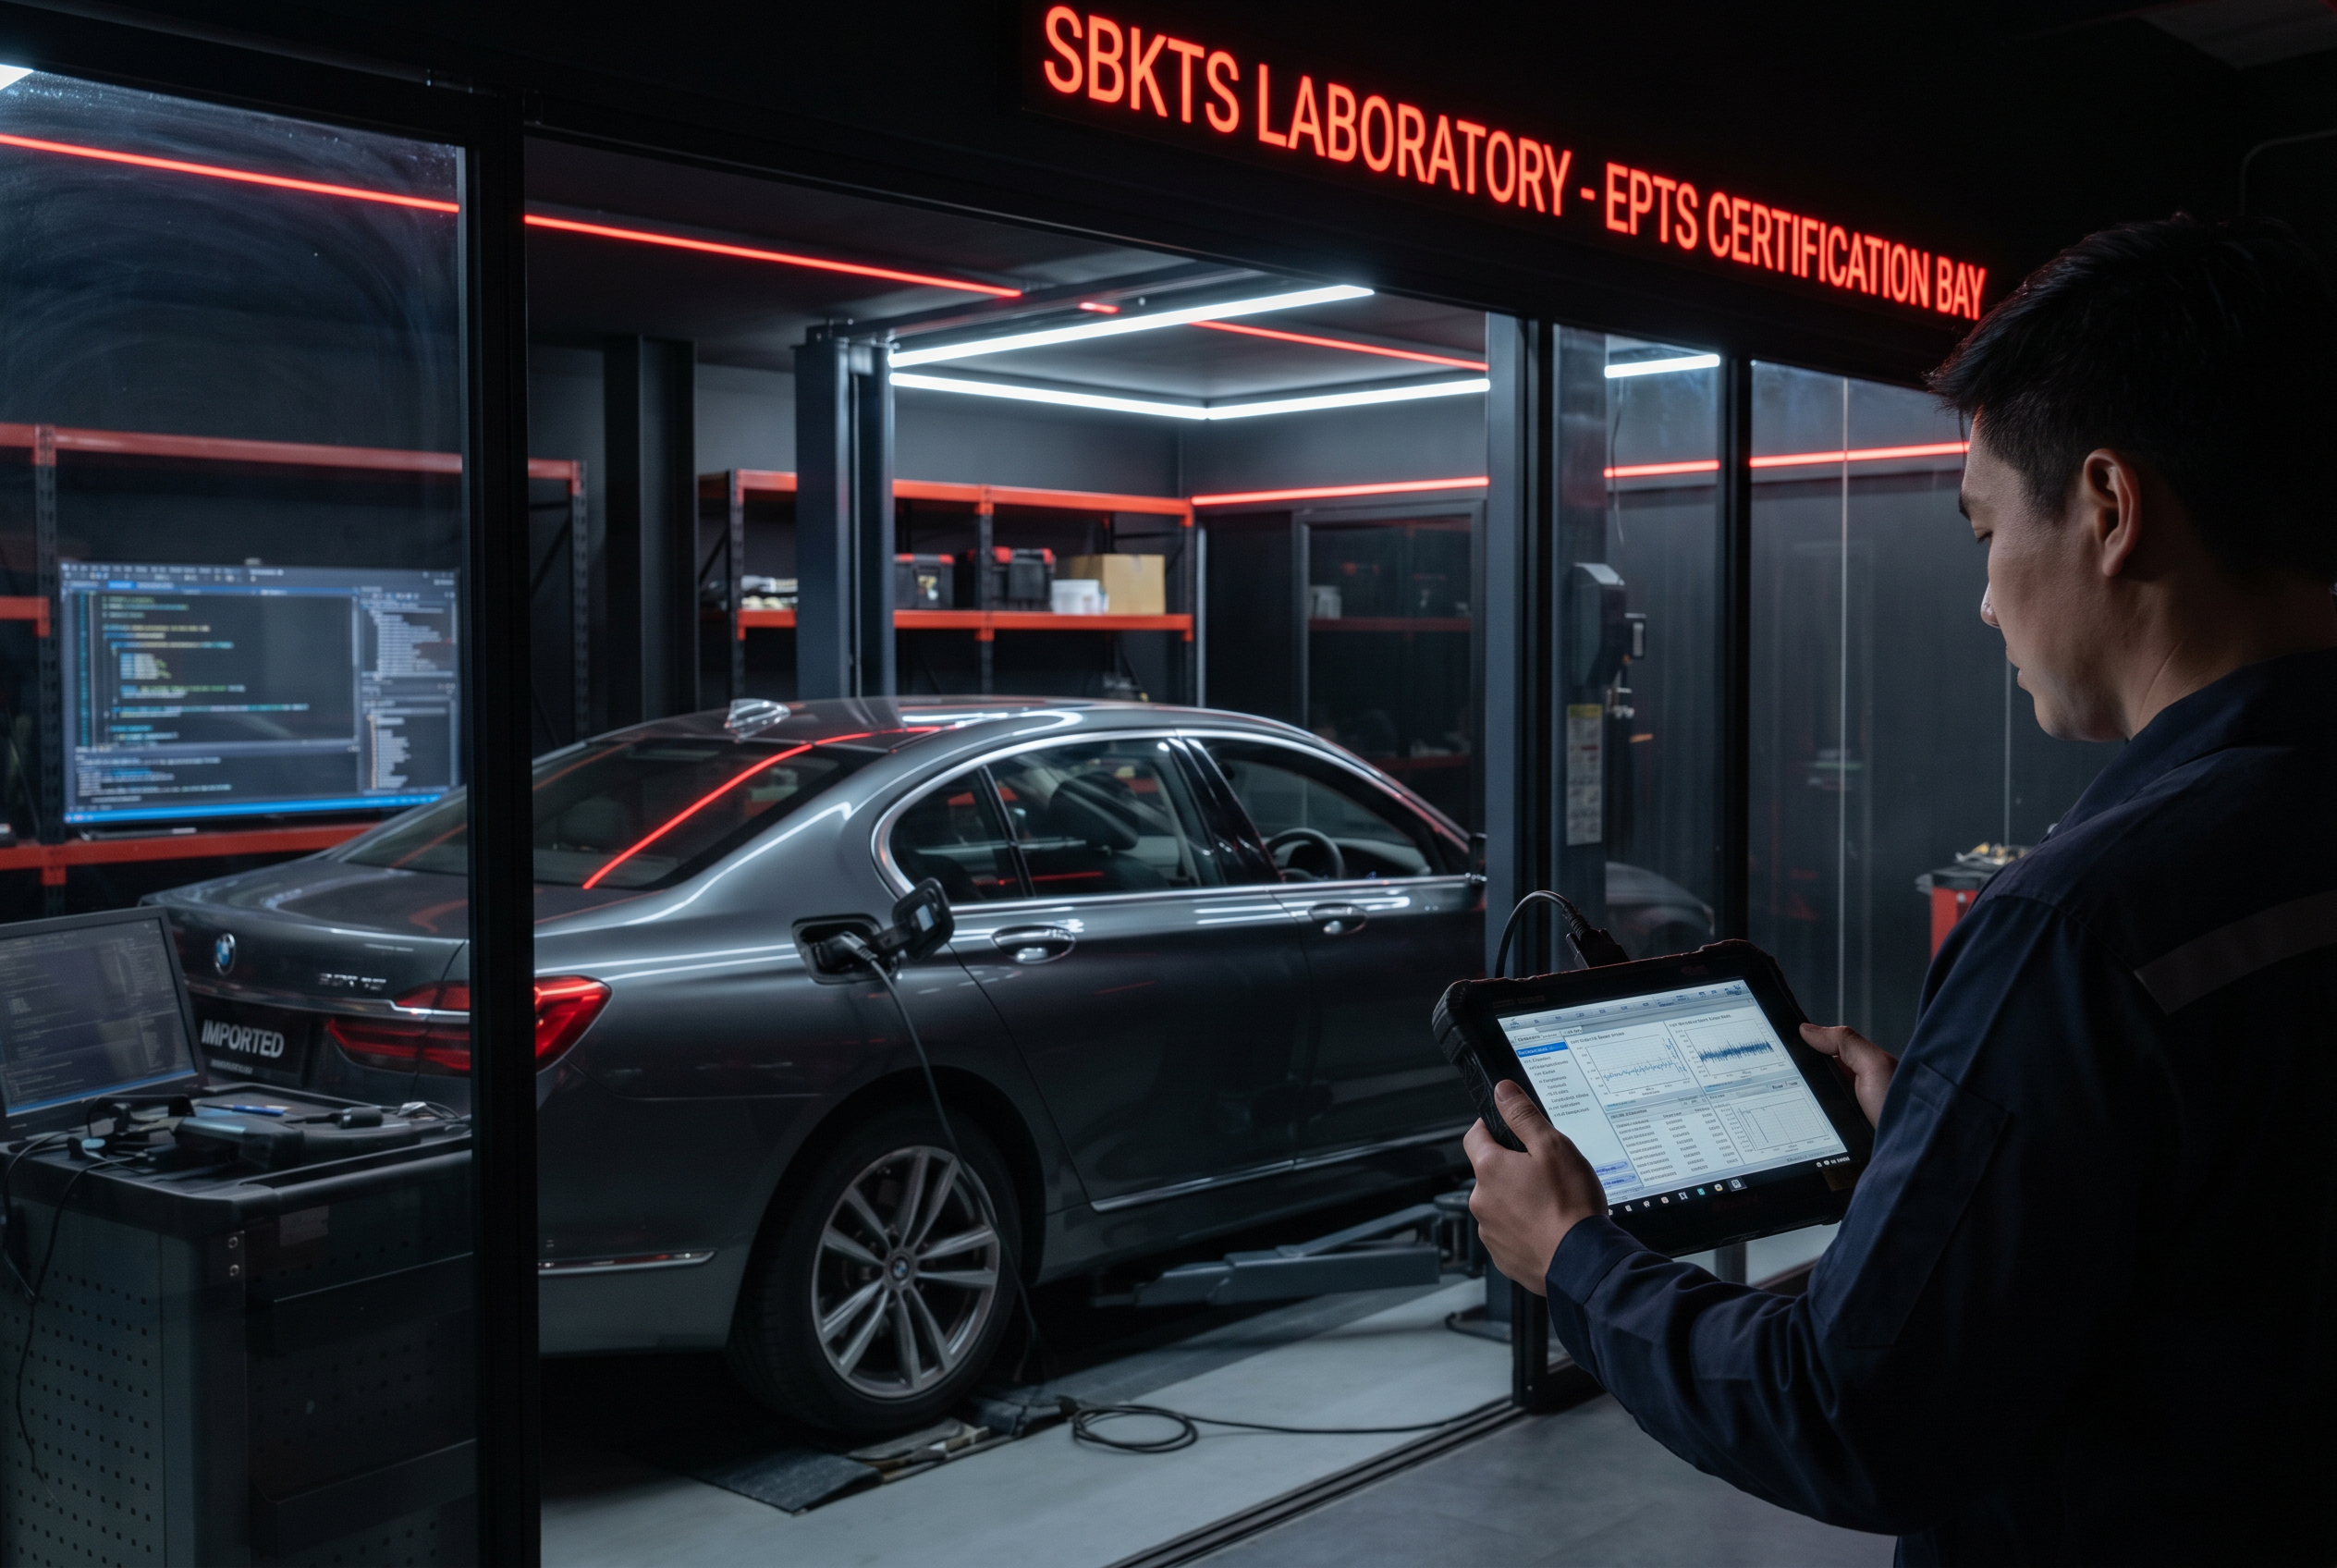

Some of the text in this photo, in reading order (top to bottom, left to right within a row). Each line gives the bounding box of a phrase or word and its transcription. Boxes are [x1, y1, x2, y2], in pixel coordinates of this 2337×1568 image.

[1044, 5, 1987, 321] SBKTS LABORATORY - EPTS CERTIFICATION BAY
[201, 1019, 285, 1059] IMPORTED
